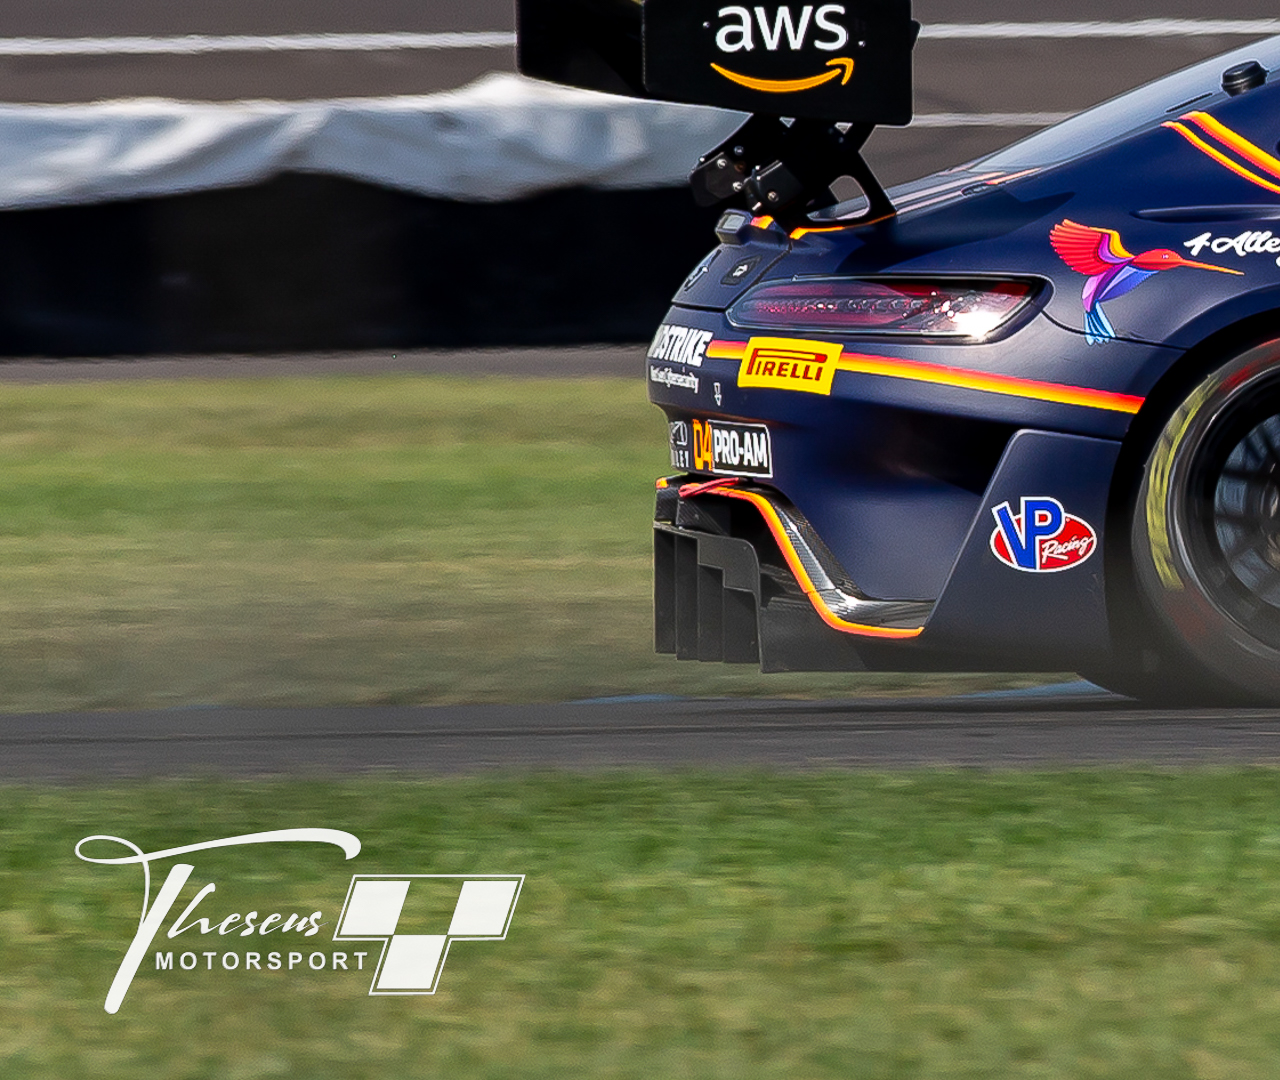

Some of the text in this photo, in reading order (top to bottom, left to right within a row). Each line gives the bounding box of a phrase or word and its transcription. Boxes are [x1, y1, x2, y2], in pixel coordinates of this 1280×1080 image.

[715, 4, 849, 53] aws
[746, 348, 828, 382] PIRELLI
[713, 429, 768, 468] PRO-AM
[997, 500, 1062, 570] VP
[1042, 535, 1093, 564] Racing
